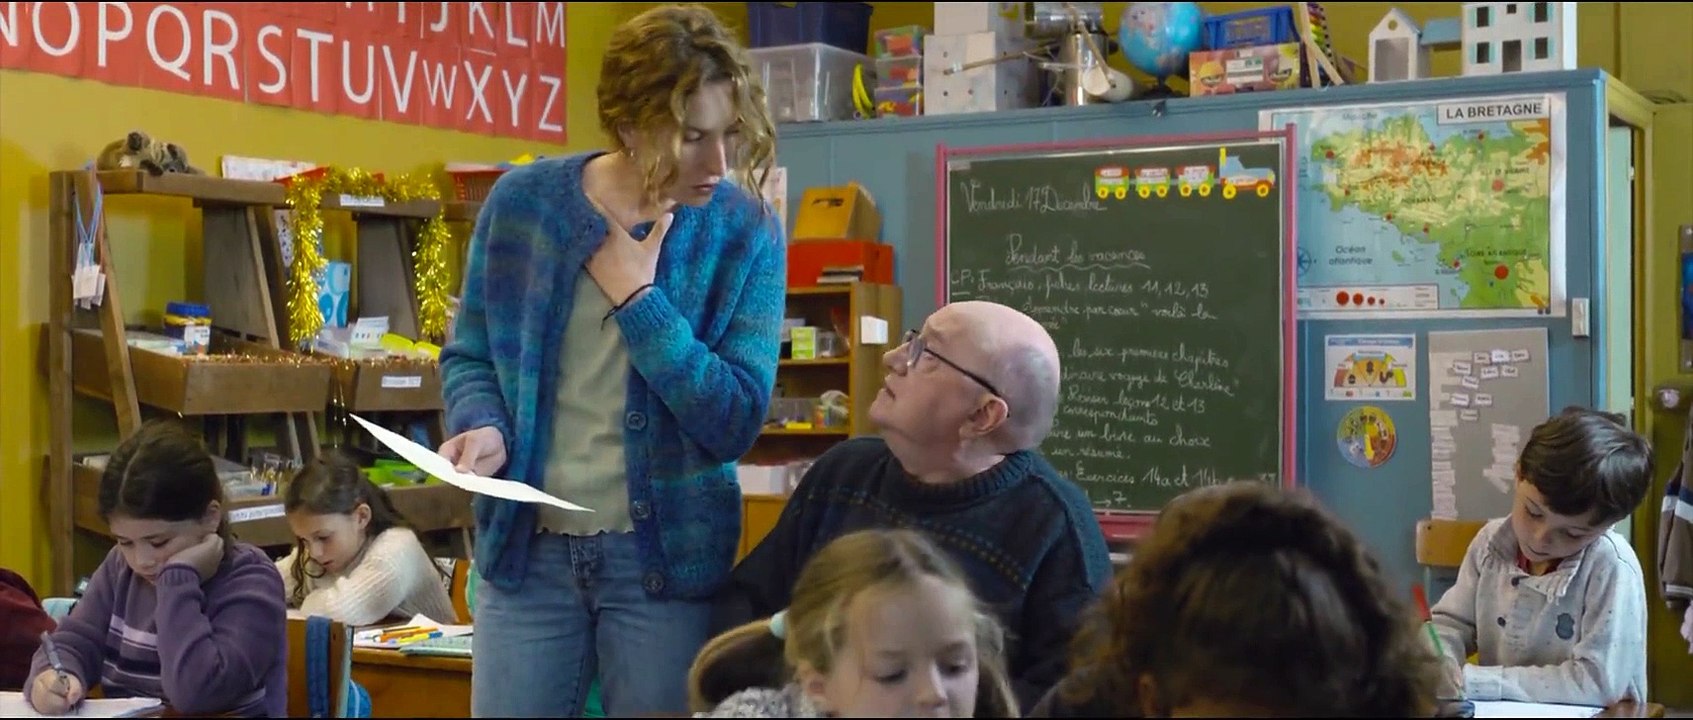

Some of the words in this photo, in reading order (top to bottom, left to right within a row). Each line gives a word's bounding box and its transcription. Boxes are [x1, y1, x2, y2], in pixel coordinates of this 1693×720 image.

[1446, 107, 1464, 120] LA
[1467, 102, 1543, 119] BRETAGNE
[960, 179, 1022, 213] Vendredi
[1005, 233, 1060, 265] Pendant
[1335, 244, 1367, 255] Océan
[1328, 256, 1374, 267] atlantique
[1168, 423, 1210, 448] choix
